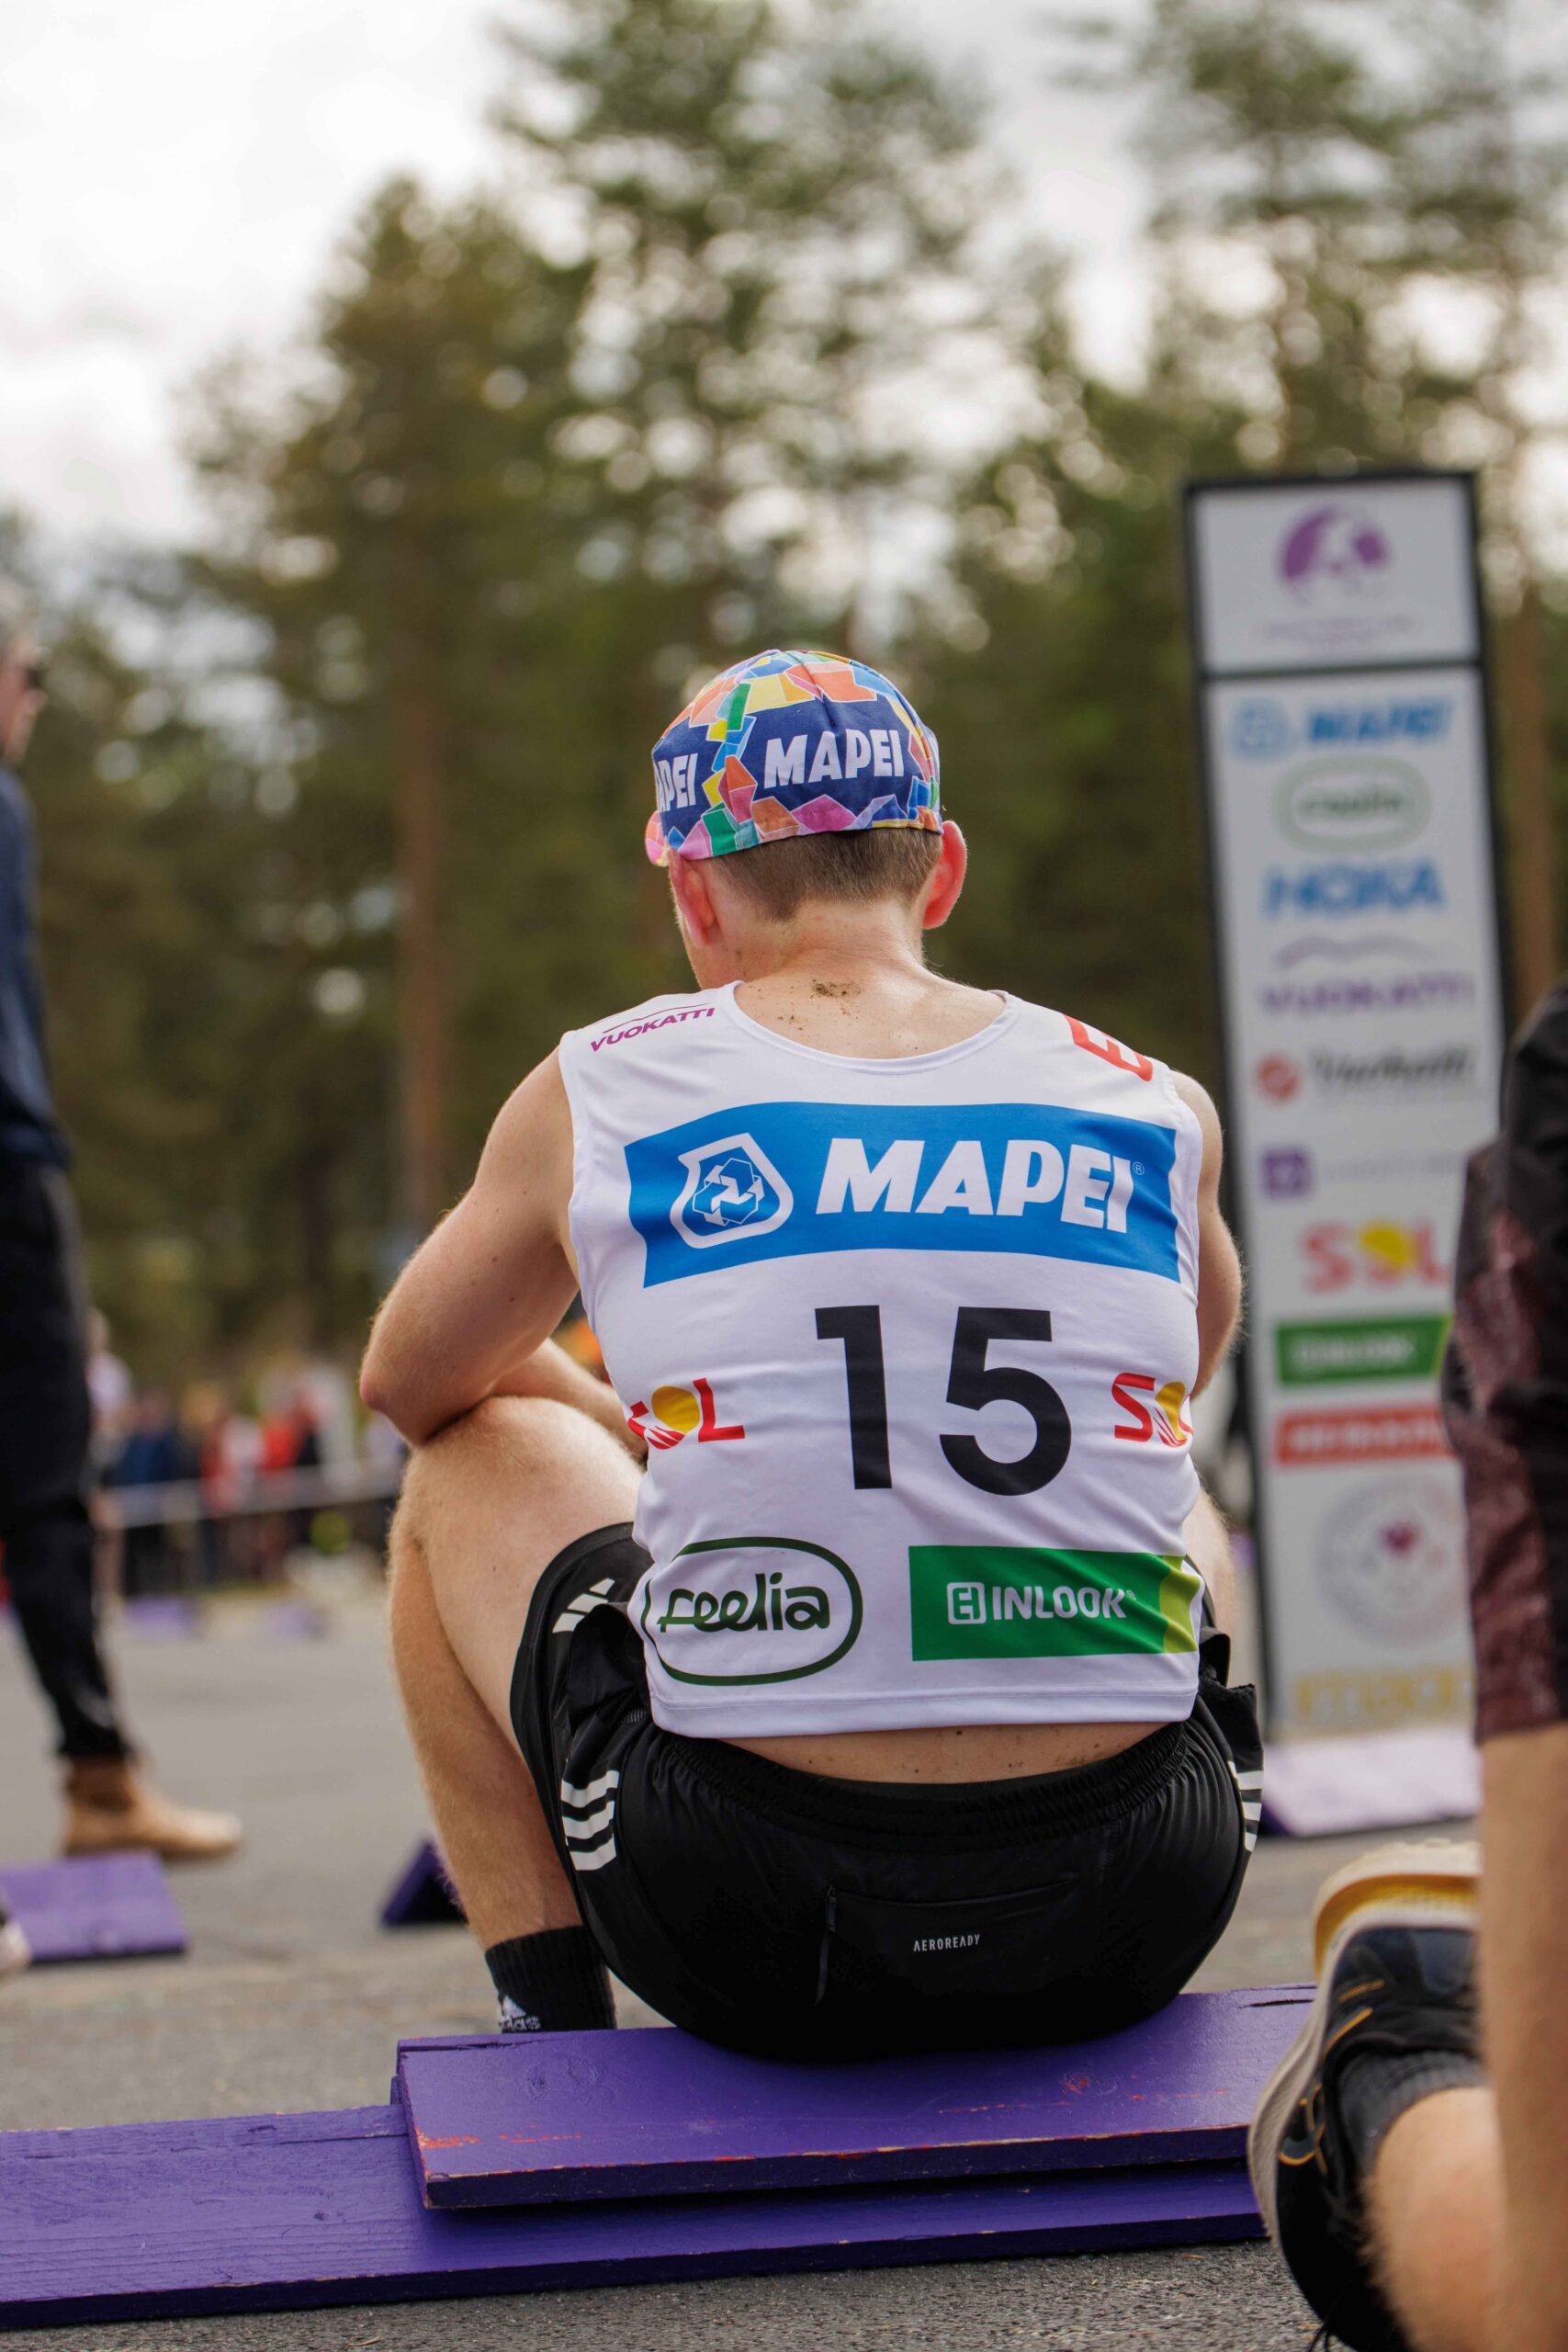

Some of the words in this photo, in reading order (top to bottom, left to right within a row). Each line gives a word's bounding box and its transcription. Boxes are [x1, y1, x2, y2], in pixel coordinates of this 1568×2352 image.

[653, 752, 698, 812] APEI
[763, 729, 905, 788] MAPEI
[591, 1007, 716, 1052] VUOKATTI
[815, 1137, 1134, 1233] MAPEI
[815, 1304, 1072, 1497] 15
[1111, 1372, 1193, 1448] SO
[991, 1586, 1127, 1621] INLOOK
[913, 1934, 980, 1952] AEROREADY
